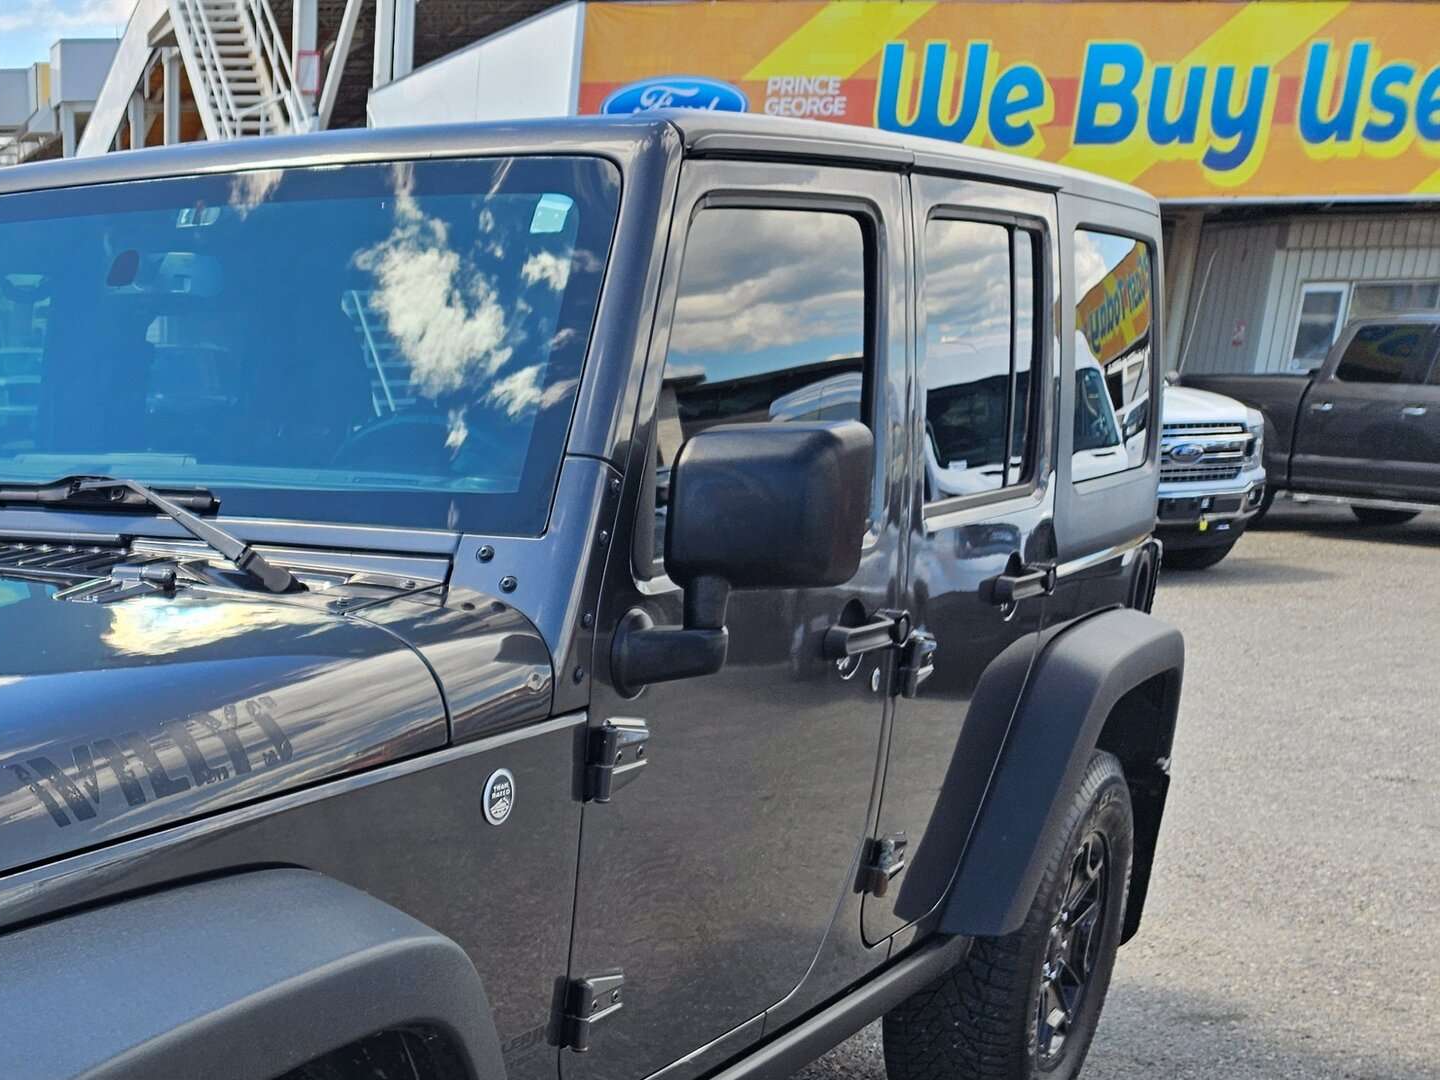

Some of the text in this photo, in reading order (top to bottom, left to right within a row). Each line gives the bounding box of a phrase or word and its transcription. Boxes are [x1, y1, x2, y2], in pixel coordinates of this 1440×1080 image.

[764, 96, 847, 117] GEORGE
[766, 75, 841, 95] PRINCE
[875, 42, 1047, 147] We
[1072, 42, 1271, 172] Buy
[2, 695, 294, 828] WILLYS
